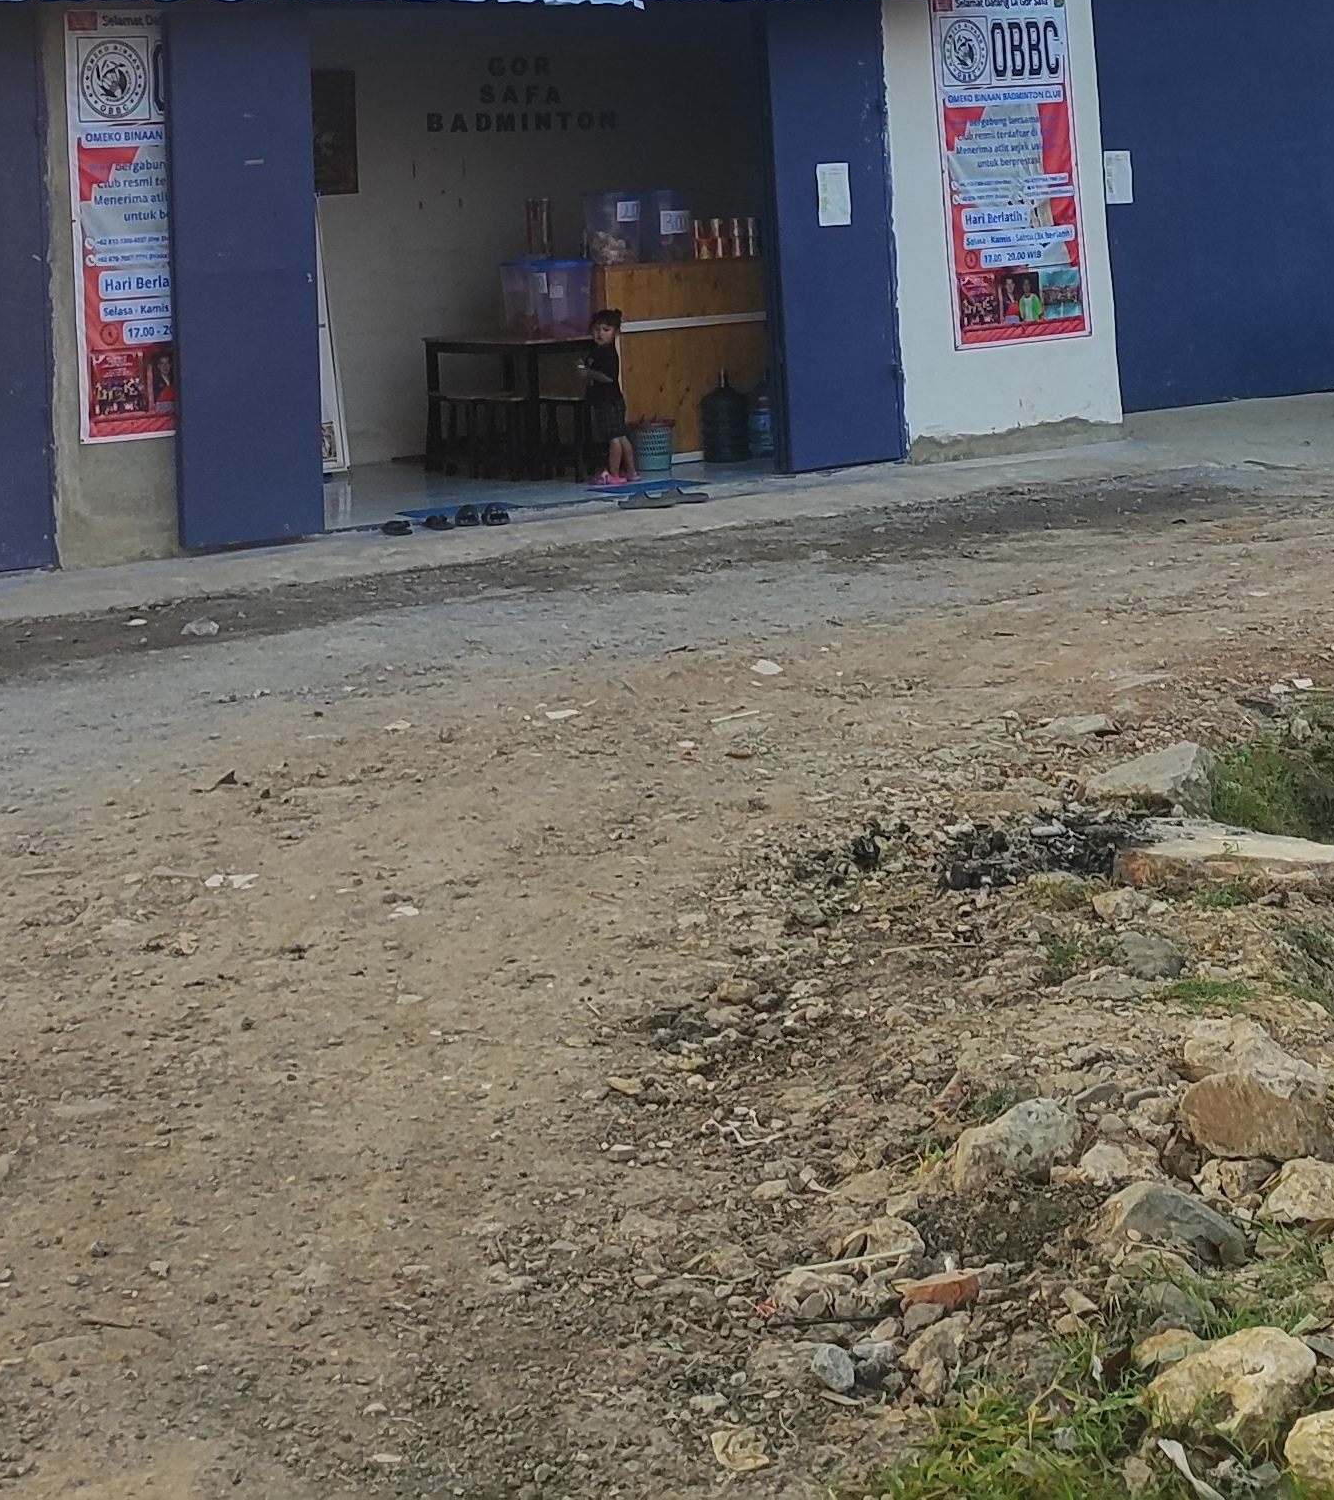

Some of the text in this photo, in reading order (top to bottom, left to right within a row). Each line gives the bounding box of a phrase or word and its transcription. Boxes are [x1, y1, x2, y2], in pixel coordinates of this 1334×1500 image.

[102, 15, 143, 27] Selamat
[991, 19, 1060, 78] OBBC
[487, 56, 551, 77] GOR
[479, 84, 562, 105] SAFA
[1003, 91, 1044, 101] BADMINTON
[426, 111, 616, 133] BADMINTON
[85, 130, 163, 143] OMEKO BINAAN
[977, 158, 999, 168] untuk
[123, 176, 152, 188] resmi
[94, 194, 149, 206] Menerima
[124, 210, 157, 221] untuk
[965, 213, 985, 225] Hari
[987, 211, 1022, 223] Berlatih
[990, 235, 1011, 244] Kamis
[1027, 250, 1042, 259] WIB
[105, 277, 131, 292] Hari
[103, 306, 134, 317] Selasa
[140, 303, 169, 315] Kamis
[128, 326, 155, 338] 17.00
